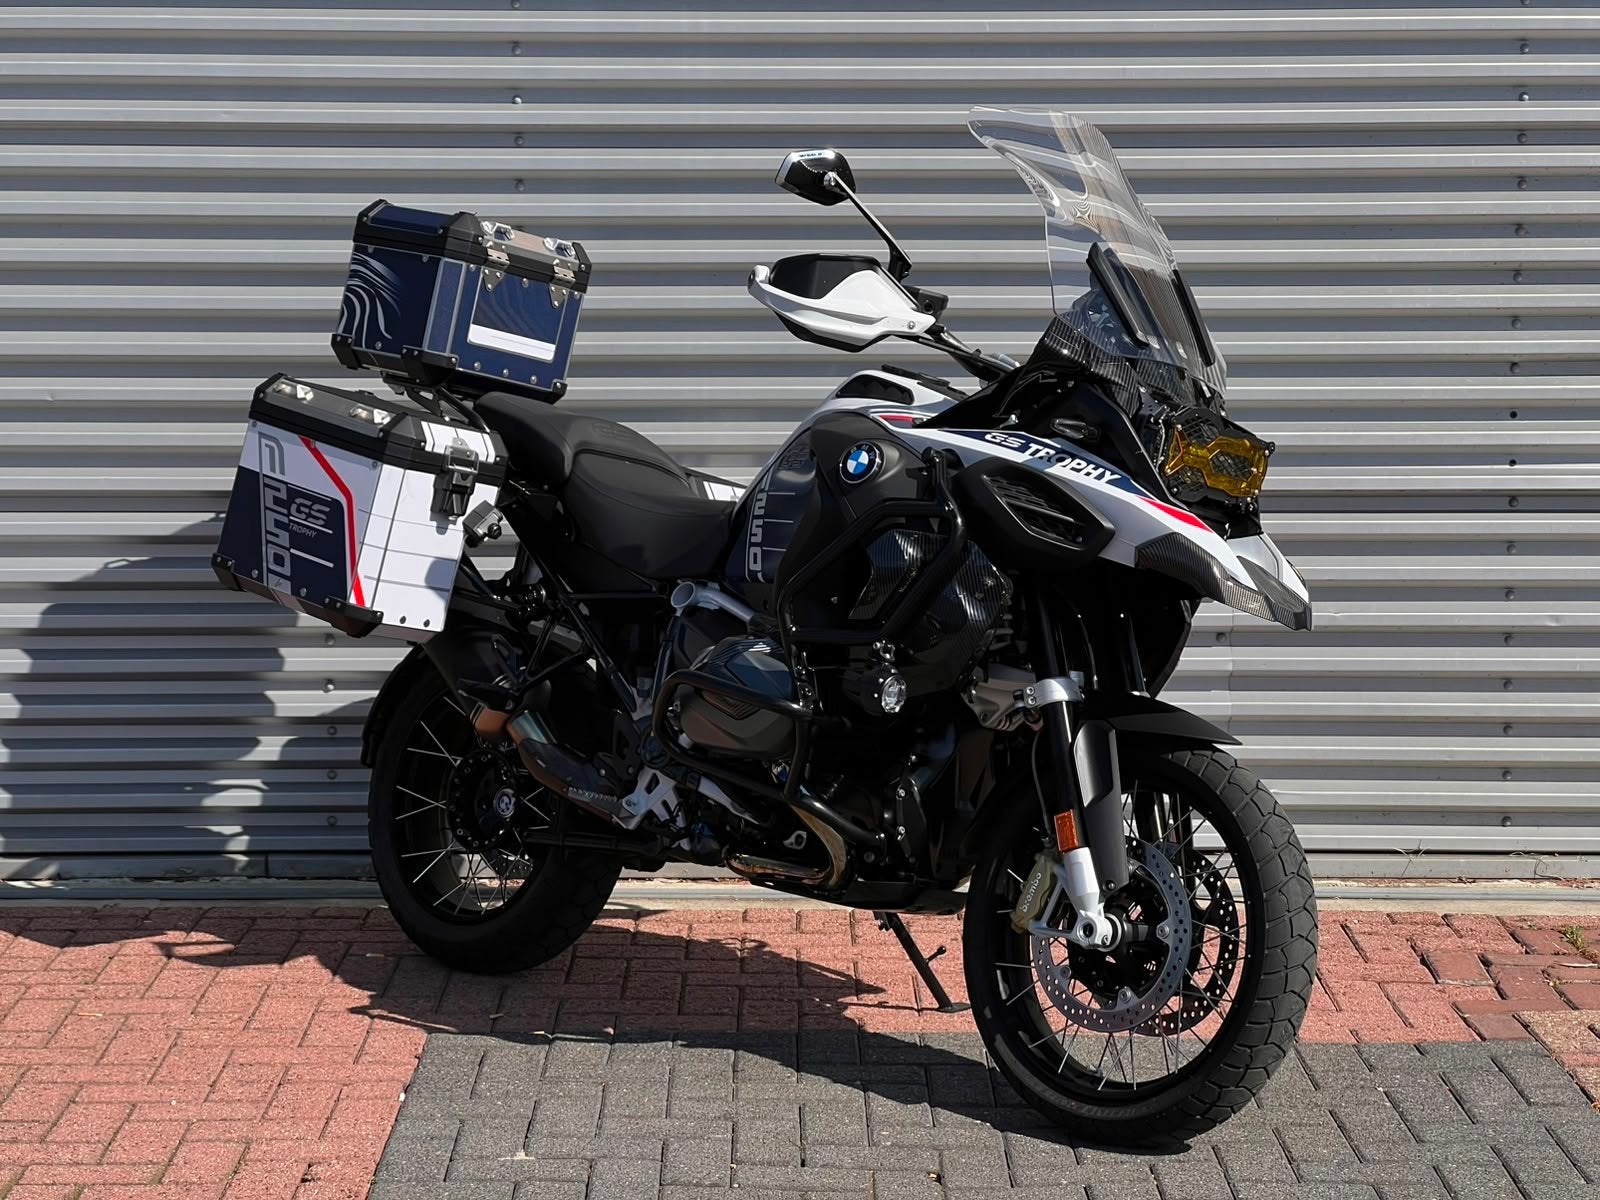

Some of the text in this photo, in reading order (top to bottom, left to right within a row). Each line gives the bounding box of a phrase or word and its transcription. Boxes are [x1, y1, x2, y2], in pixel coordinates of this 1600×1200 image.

[984, 432, 1122, 483] GS TROPHY
[290, 497, 331, 526] GS
[288, 523, 318, 538] TROPHY
[1021, 871, 1042, 913] brembo
